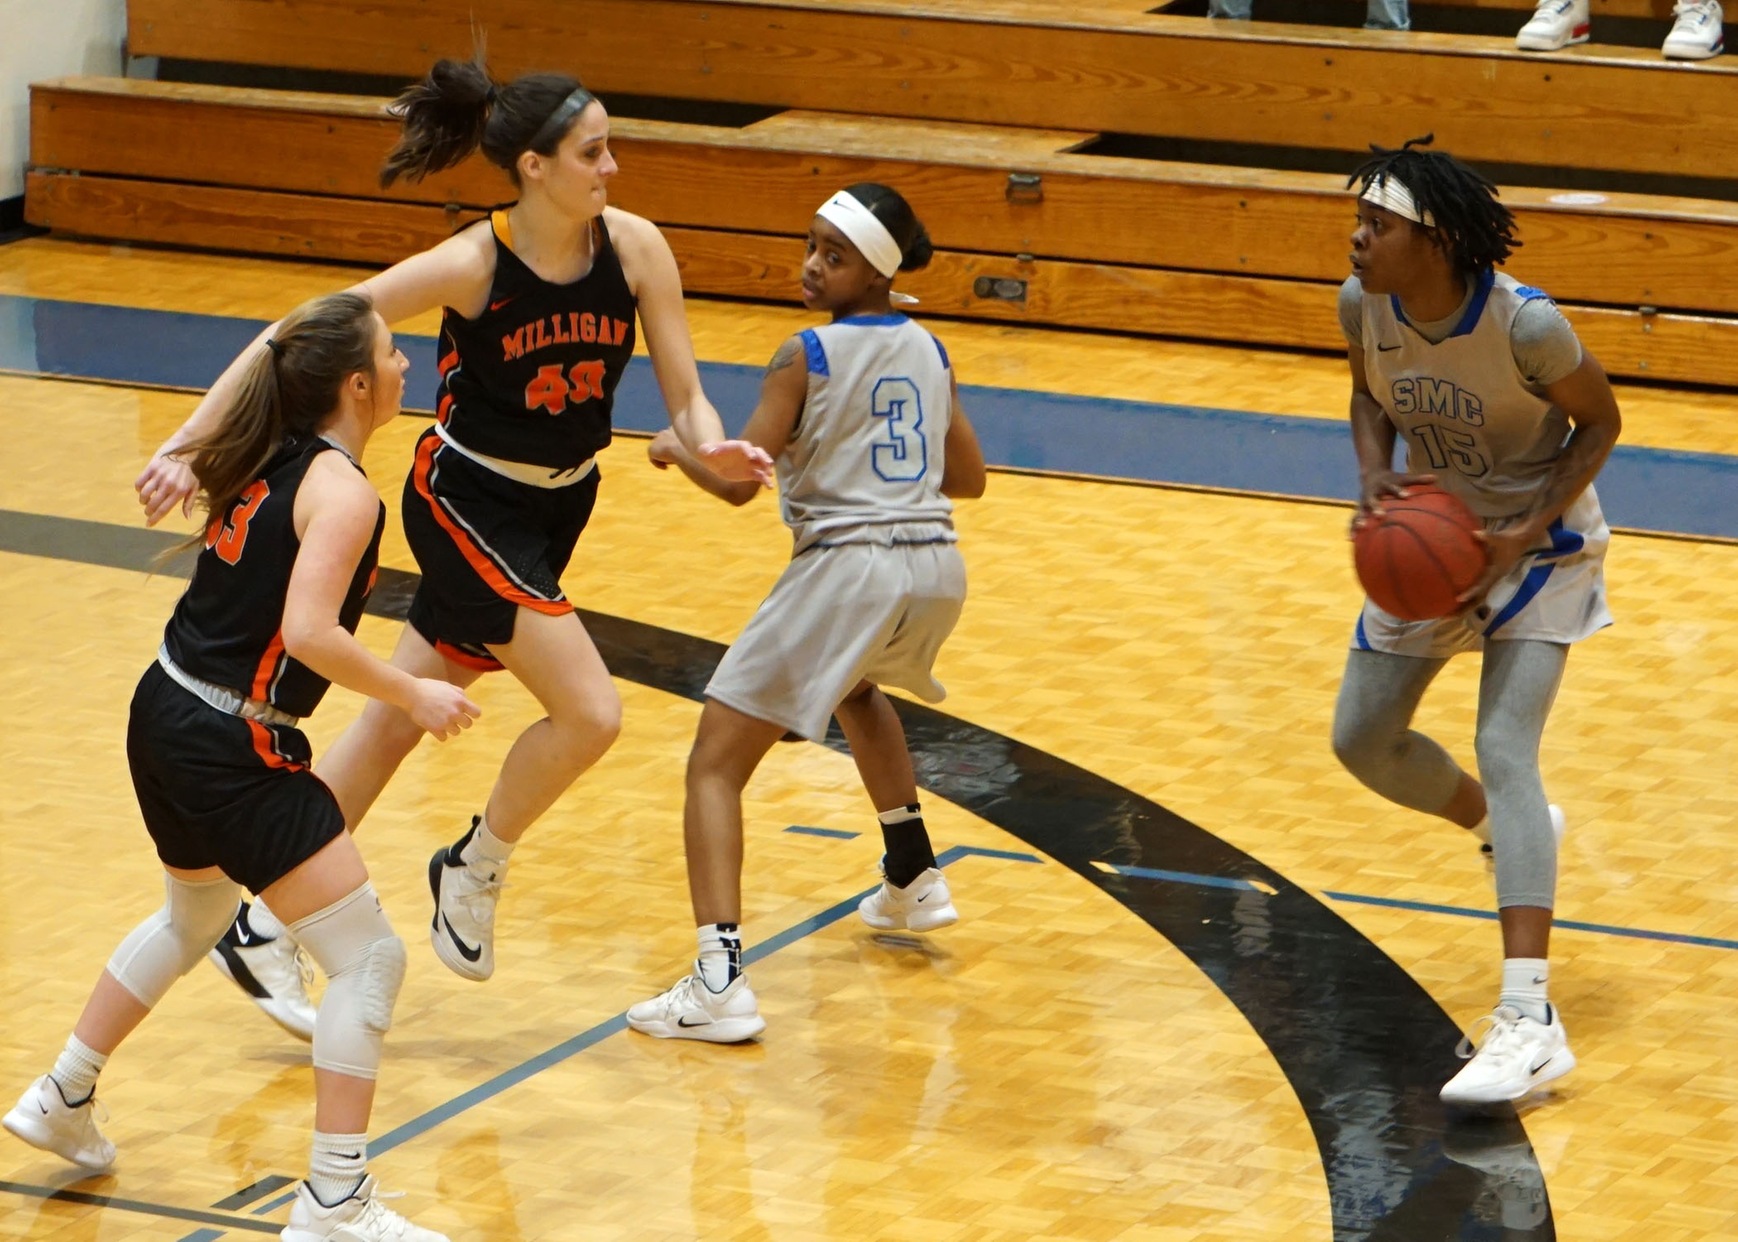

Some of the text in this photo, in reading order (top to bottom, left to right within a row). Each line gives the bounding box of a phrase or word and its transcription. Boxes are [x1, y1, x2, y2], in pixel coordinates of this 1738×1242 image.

[501, 312, 629, 361] MILLIGAN
[1392, 377, 1485, 427] SMC
[871, 377, 928, 482] 3
[1411, 423, 1488, 477] 15
